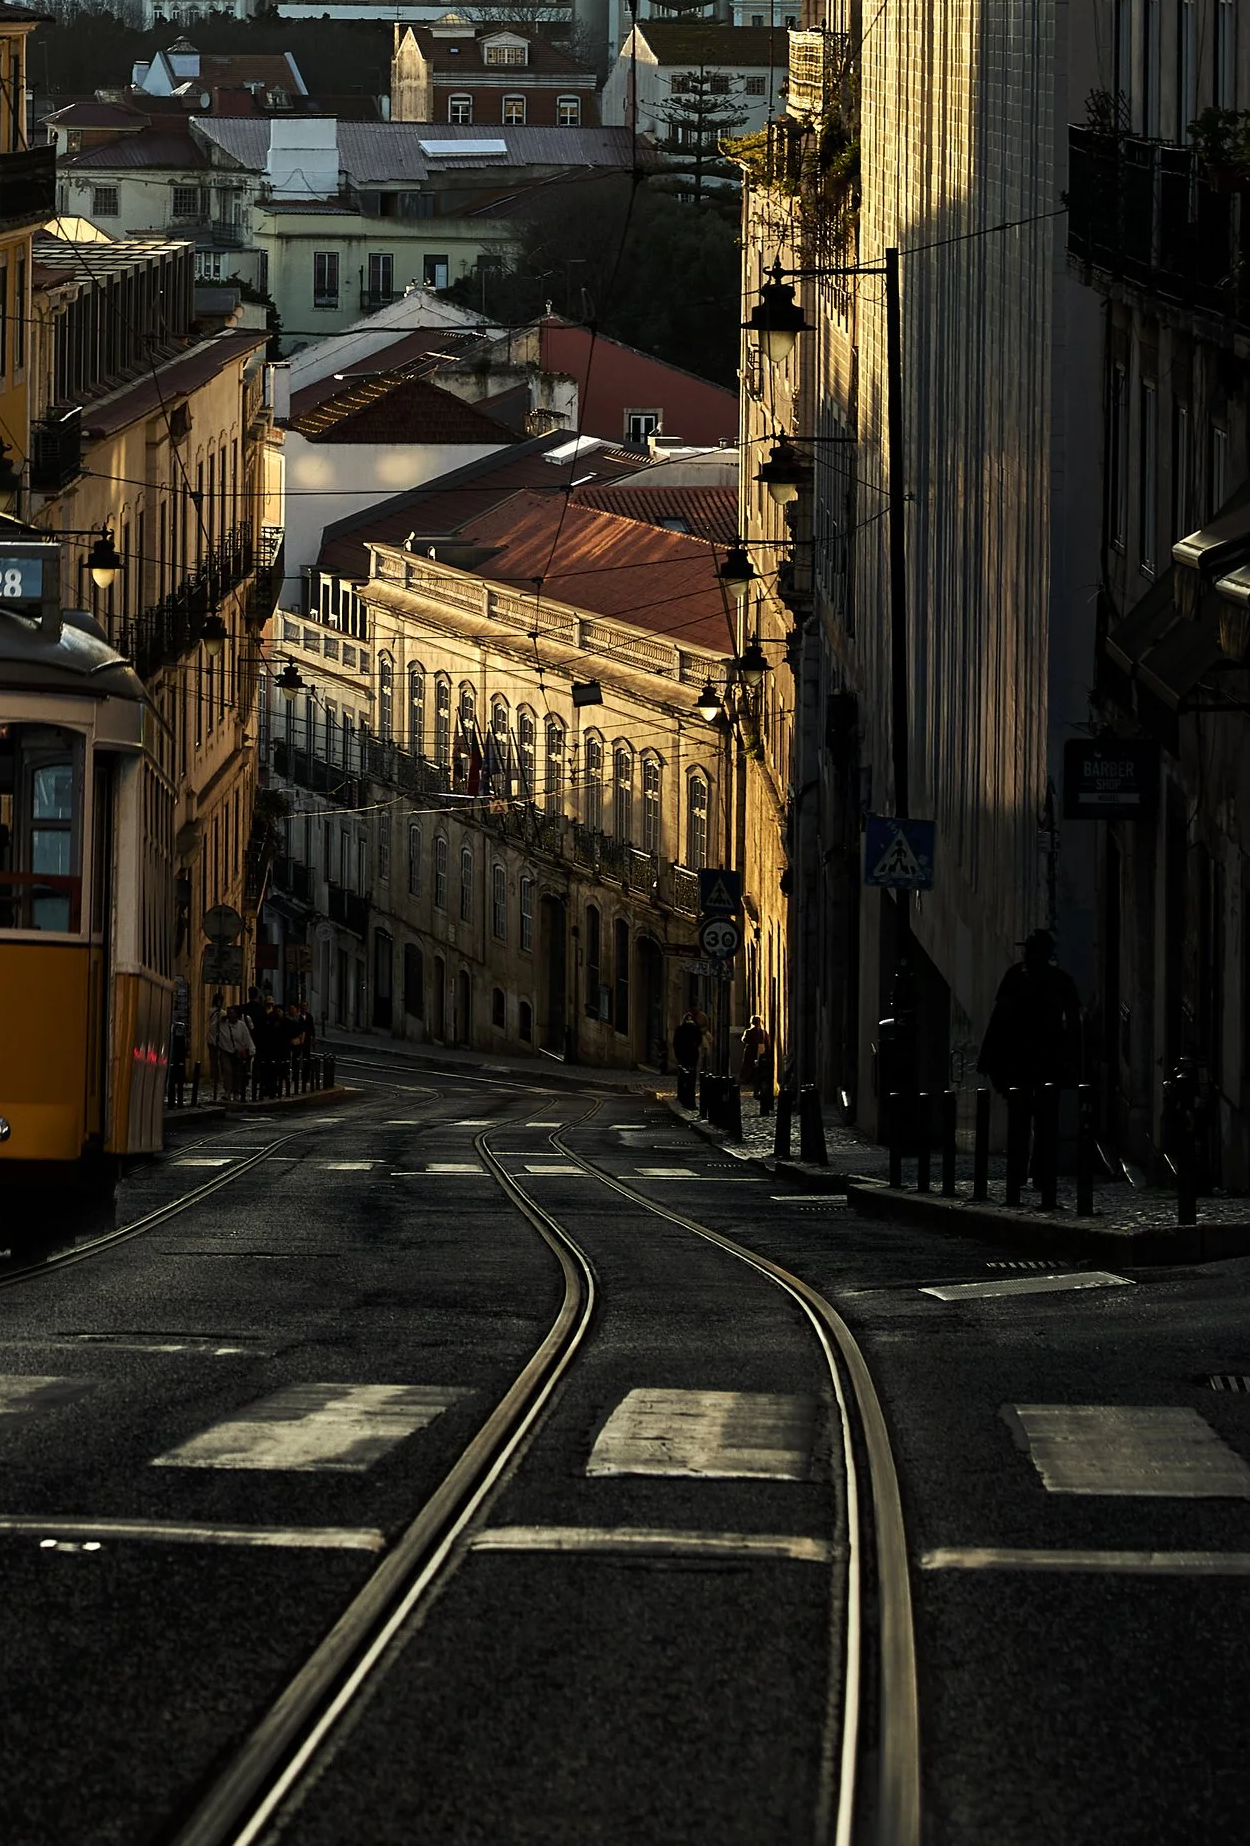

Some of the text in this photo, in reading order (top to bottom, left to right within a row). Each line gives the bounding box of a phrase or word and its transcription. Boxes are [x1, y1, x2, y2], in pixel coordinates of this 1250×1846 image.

[1083, 760, 1134, 778] BARBER
[1095, 778, 1122, 791] SHOP
[706, 930, 735, 948] 30
